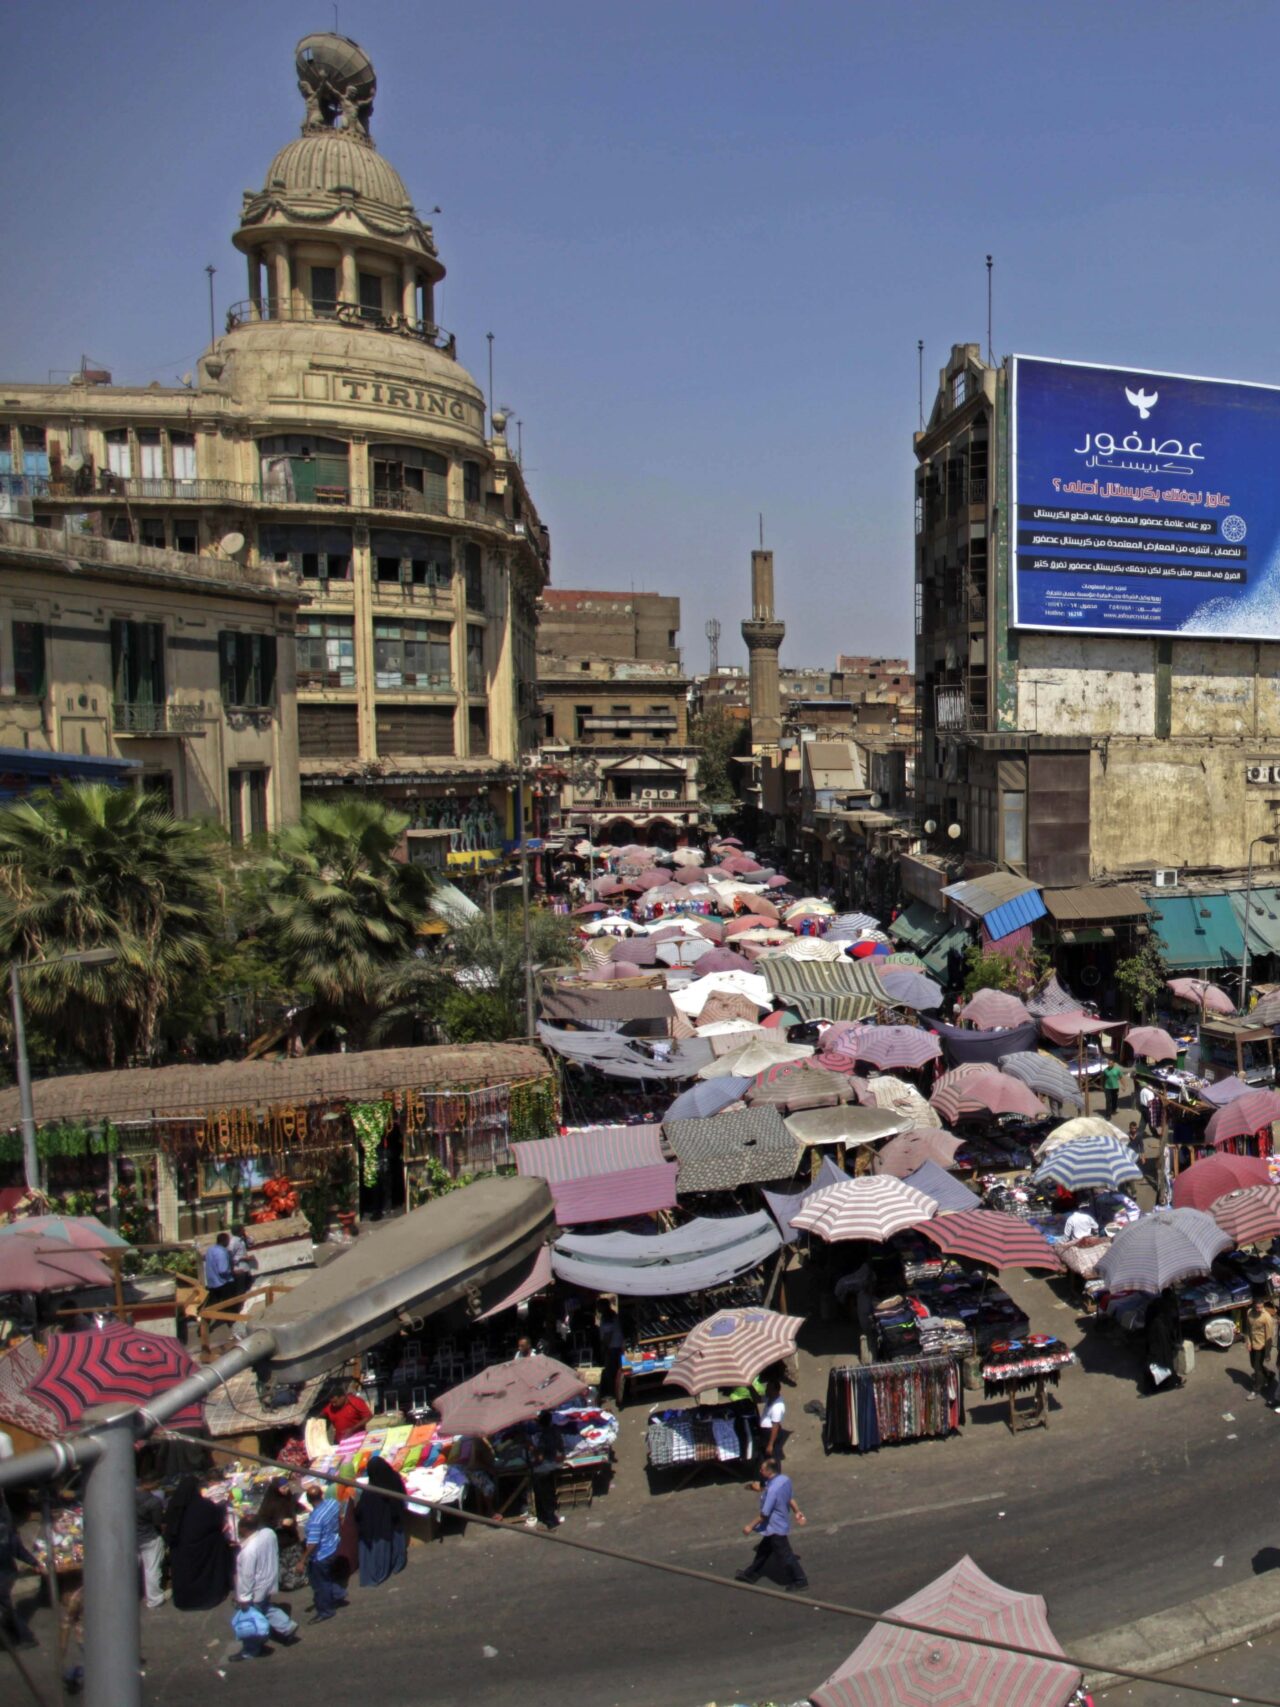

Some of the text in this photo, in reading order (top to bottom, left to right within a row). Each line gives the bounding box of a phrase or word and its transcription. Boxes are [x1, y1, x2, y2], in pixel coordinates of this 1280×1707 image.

[342, 379, 466, 421] TIRING
[1074, 430, 1205, 459] عصفور
[1086, 455, 1194, 475] كريستال
[1100, 482, 1160, 502] بكريستال
[1162, 488, 1203, 506] نجفتك
[1204, 490, 1231, 507] عاوز
[1033, 509, 1069, 519] الكريستال
[1071, 511, 1089, 522] قطع
[1105, 514, 1138, 524] المحفورة
[1139, 517, 1163, 527] عصفور
[1164, 518, 1183, 528] علامة
[1199, 522, 1211, 531] دور
[1032, 535, 1059, 544] عصفور
[1060, 536, 1092, 546] كريستال
[1093, 539, 1106, 547] من
[1106, 538, 1142, 550] المعتمدة
[1143, 541, 1175, 552] المعارض
[1176, 543, 1188, 553] من
[1068, 561, 1092, 571] عصفور
[1093, 562, 1124, 573] بكريستال
[1125, 564, 1147, 573] نجفتك
[1147, 566, 1161, 575] لكن
[1177, 568, 1193, 577] مش
[1193, 569, 1211, 578] السعر
[1223, 571, 1241, 580] الفرق
